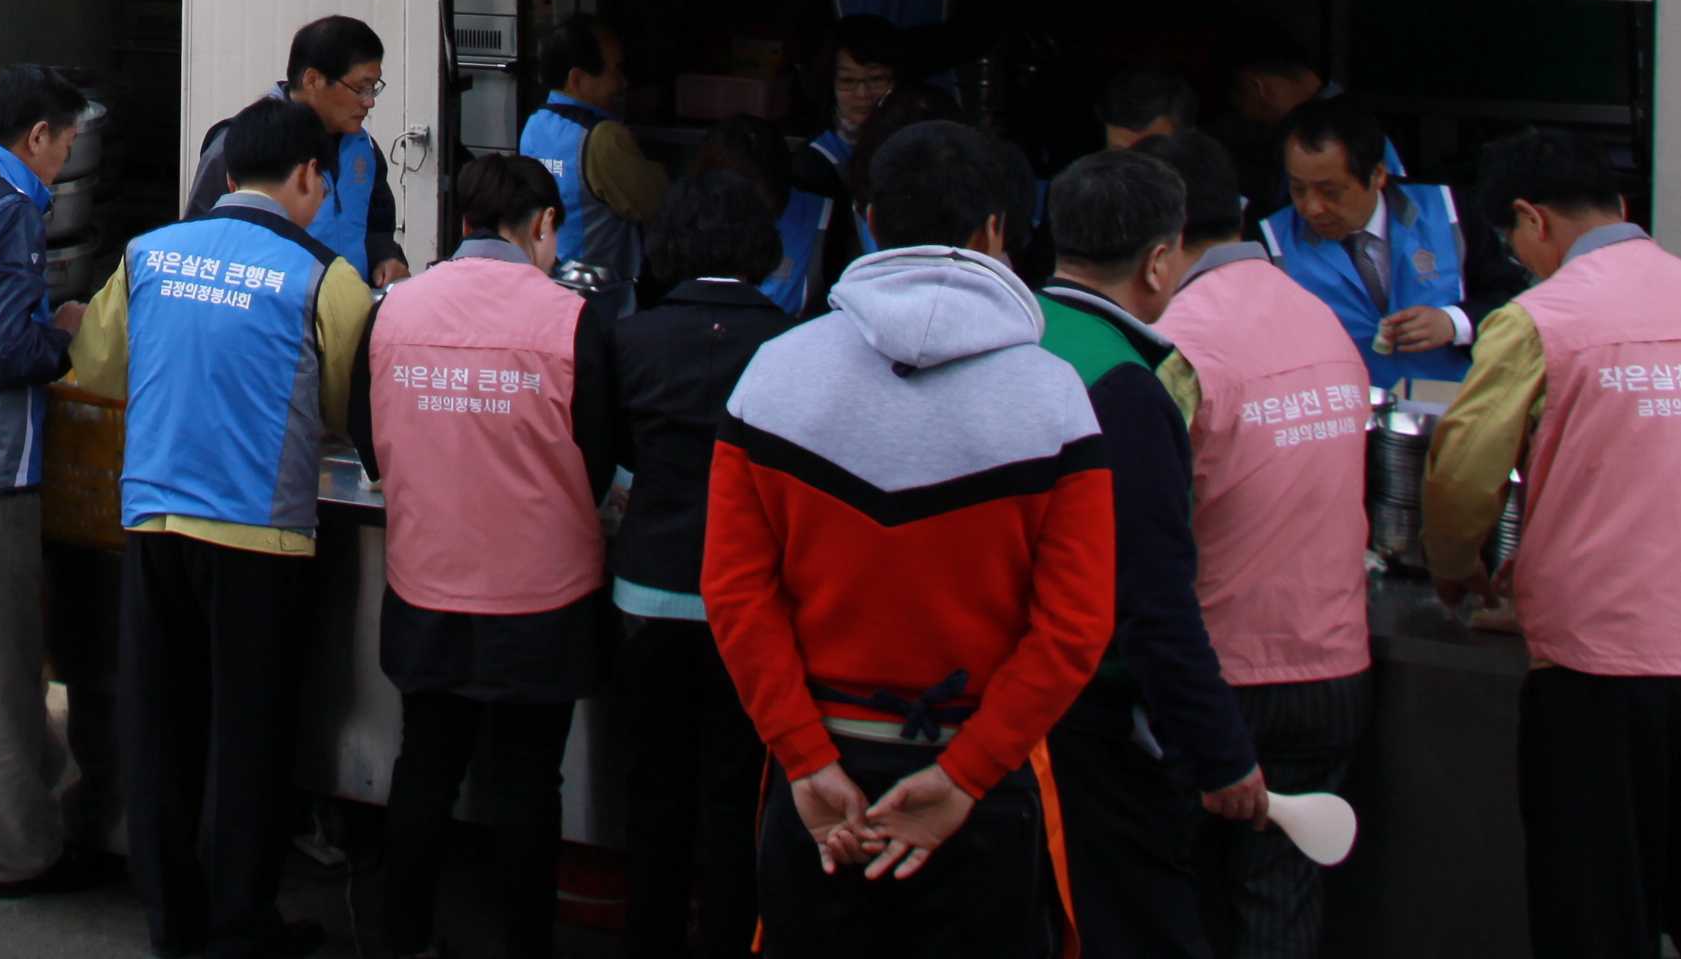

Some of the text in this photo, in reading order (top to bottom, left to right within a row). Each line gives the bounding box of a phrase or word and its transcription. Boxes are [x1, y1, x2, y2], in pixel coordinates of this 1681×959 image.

[146, 250, 286, 293] 작은실천 큰행복
[160, 280, 252, 310] 금정의정봉사회
[392, 365, 542, 394] 작은실천 큰행복
[1241, 388, 1323, 426] 작은실천
